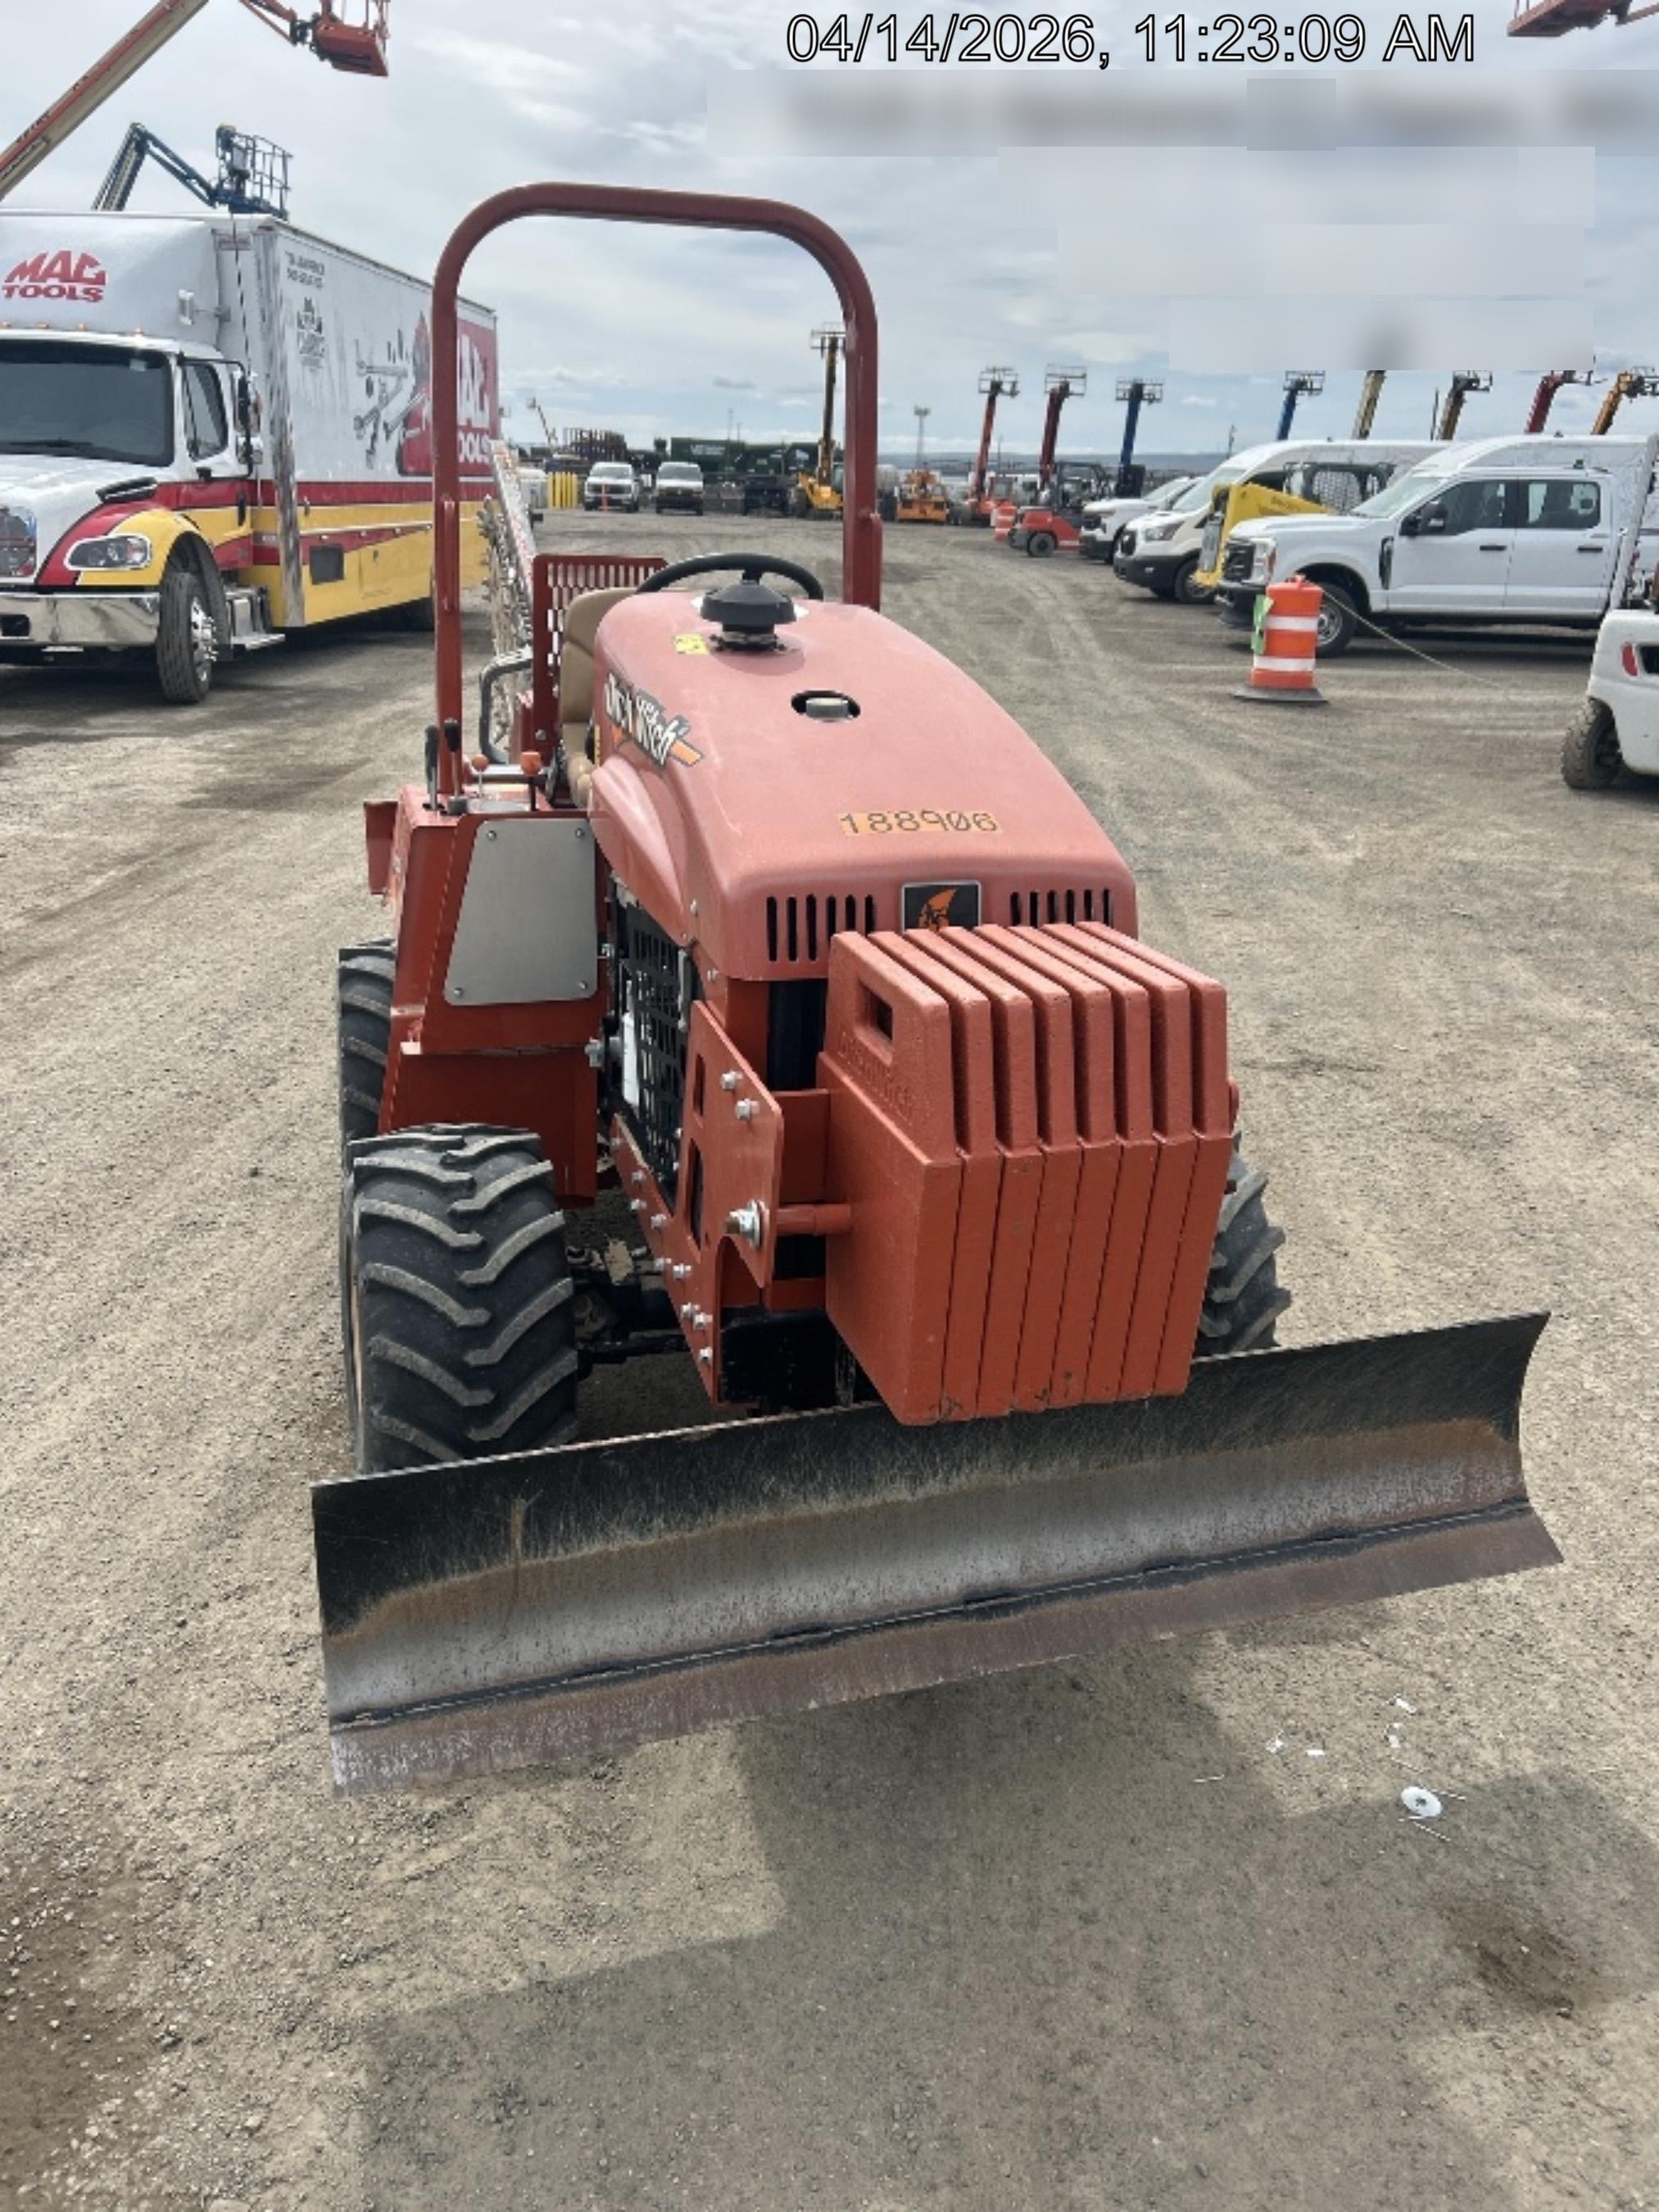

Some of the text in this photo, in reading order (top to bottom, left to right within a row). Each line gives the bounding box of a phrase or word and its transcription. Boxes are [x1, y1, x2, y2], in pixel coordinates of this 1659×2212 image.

[4, 250, 106, 285] MAC
[2, 285, 104, 302] TOOLS
[841, 809, 998, 834] 188906
